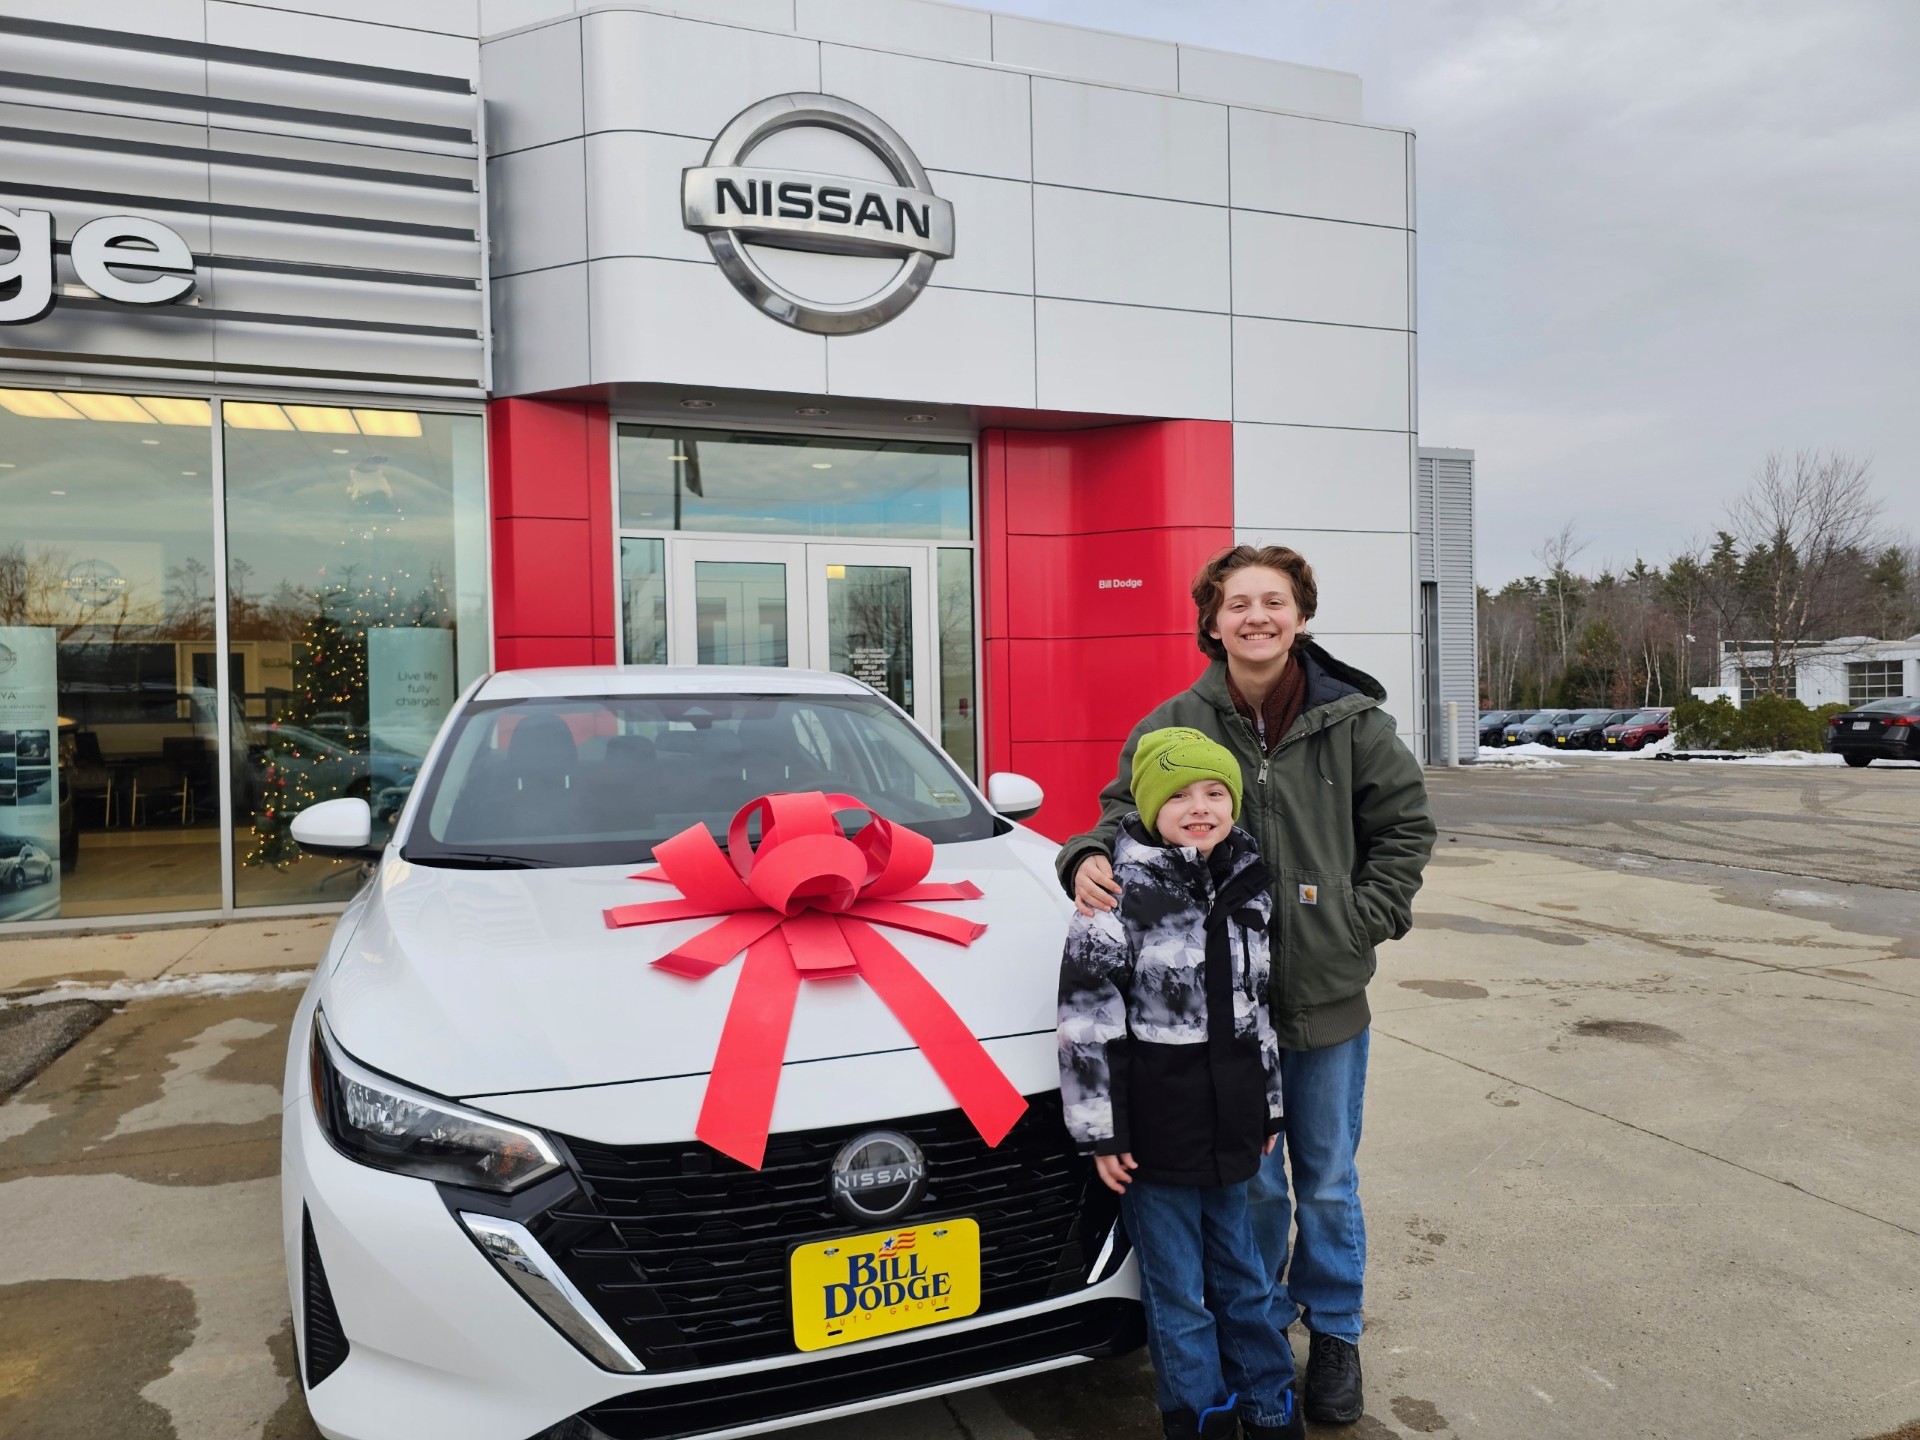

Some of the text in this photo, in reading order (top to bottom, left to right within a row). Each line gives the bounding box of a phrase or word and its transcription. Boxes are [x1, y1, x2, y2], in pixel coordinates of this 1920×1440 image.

[715, 178, 930, 239] NISSAN
[1099, 578, 1143, 589] Bill Dodge
[398, 671, 438, 681] Live life
[408, 683, 431, 694] fully
[834, 1164, 922, 1189] NISSAN
[825, 1297, 949, 1329] AUTO GROUP
